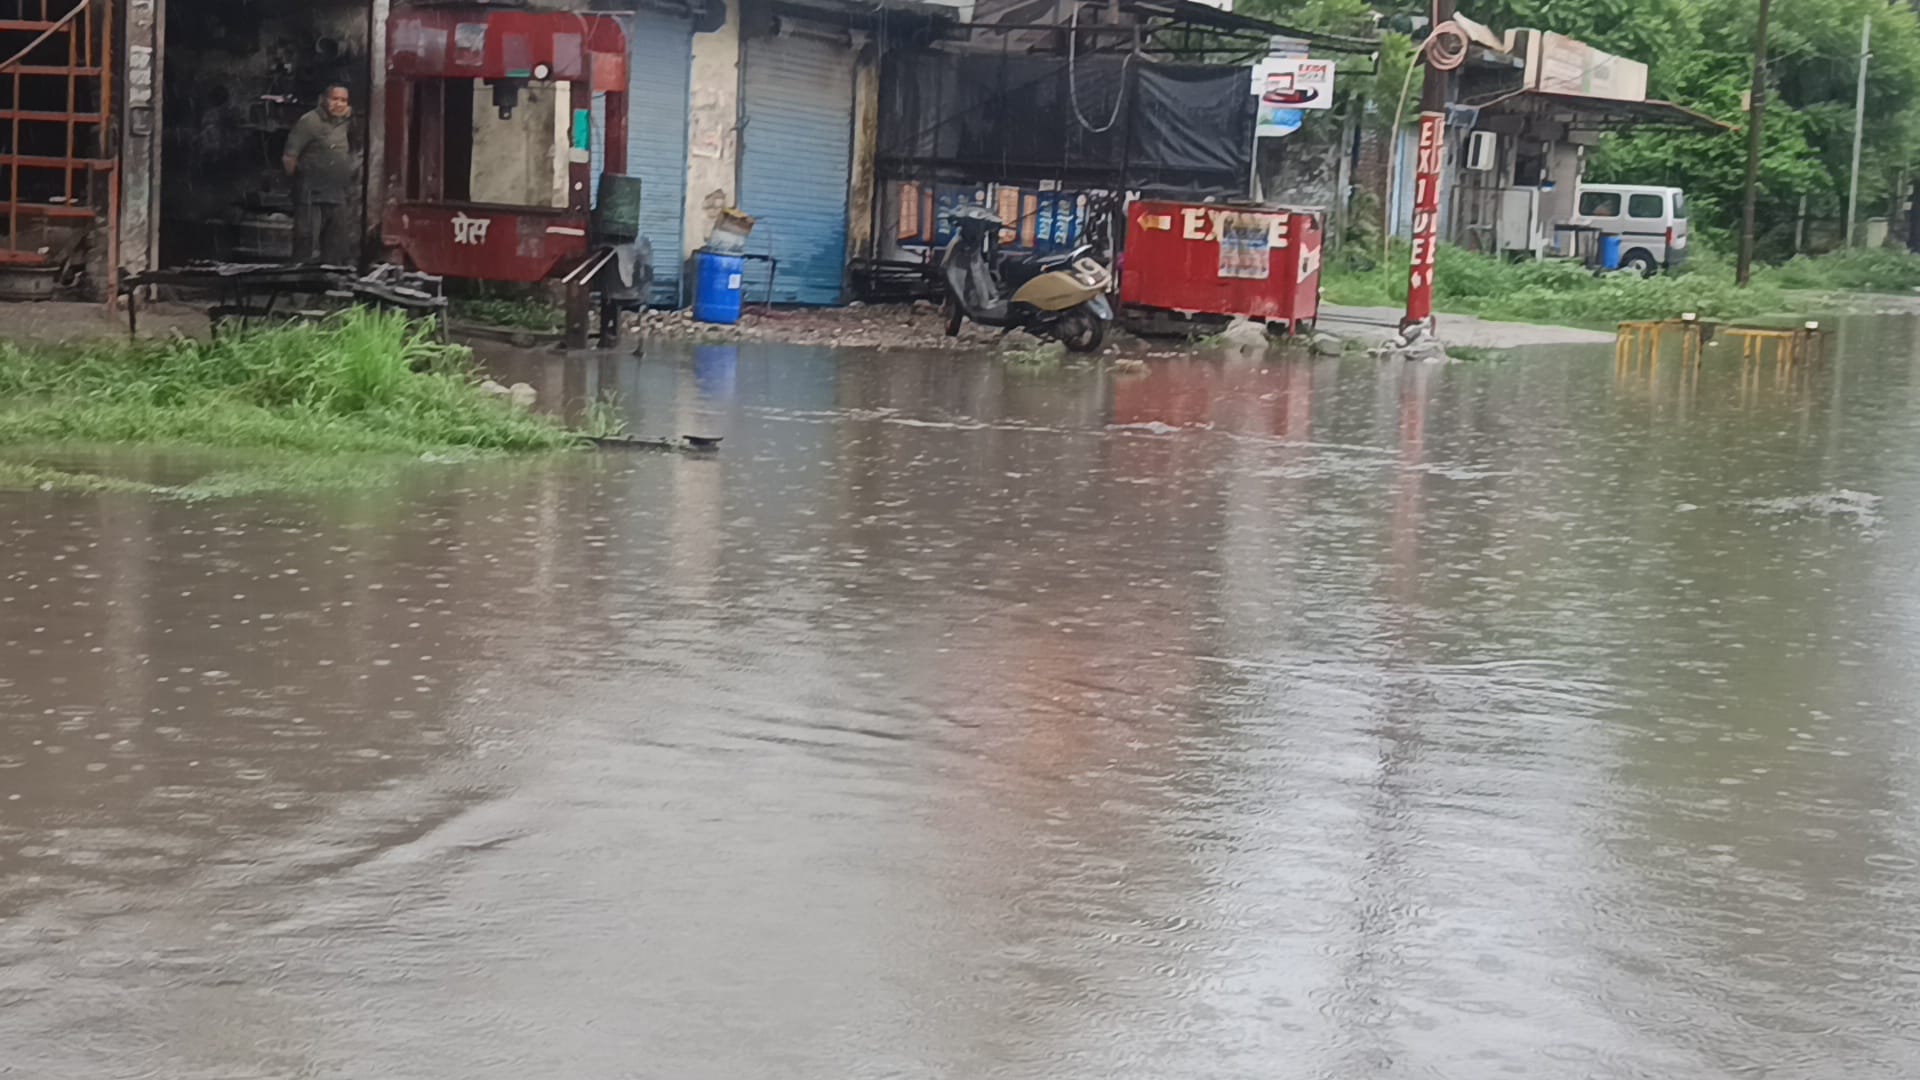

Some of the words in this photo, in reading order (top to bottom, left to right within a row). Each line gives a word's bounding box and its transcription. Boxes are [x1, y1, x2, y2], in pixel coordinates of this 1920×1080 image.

[1410, 121, 1433, 265] EXIDE
[450, 211, 491, 245] प्रेस
[1181, 207, 1289, 248] EXE
